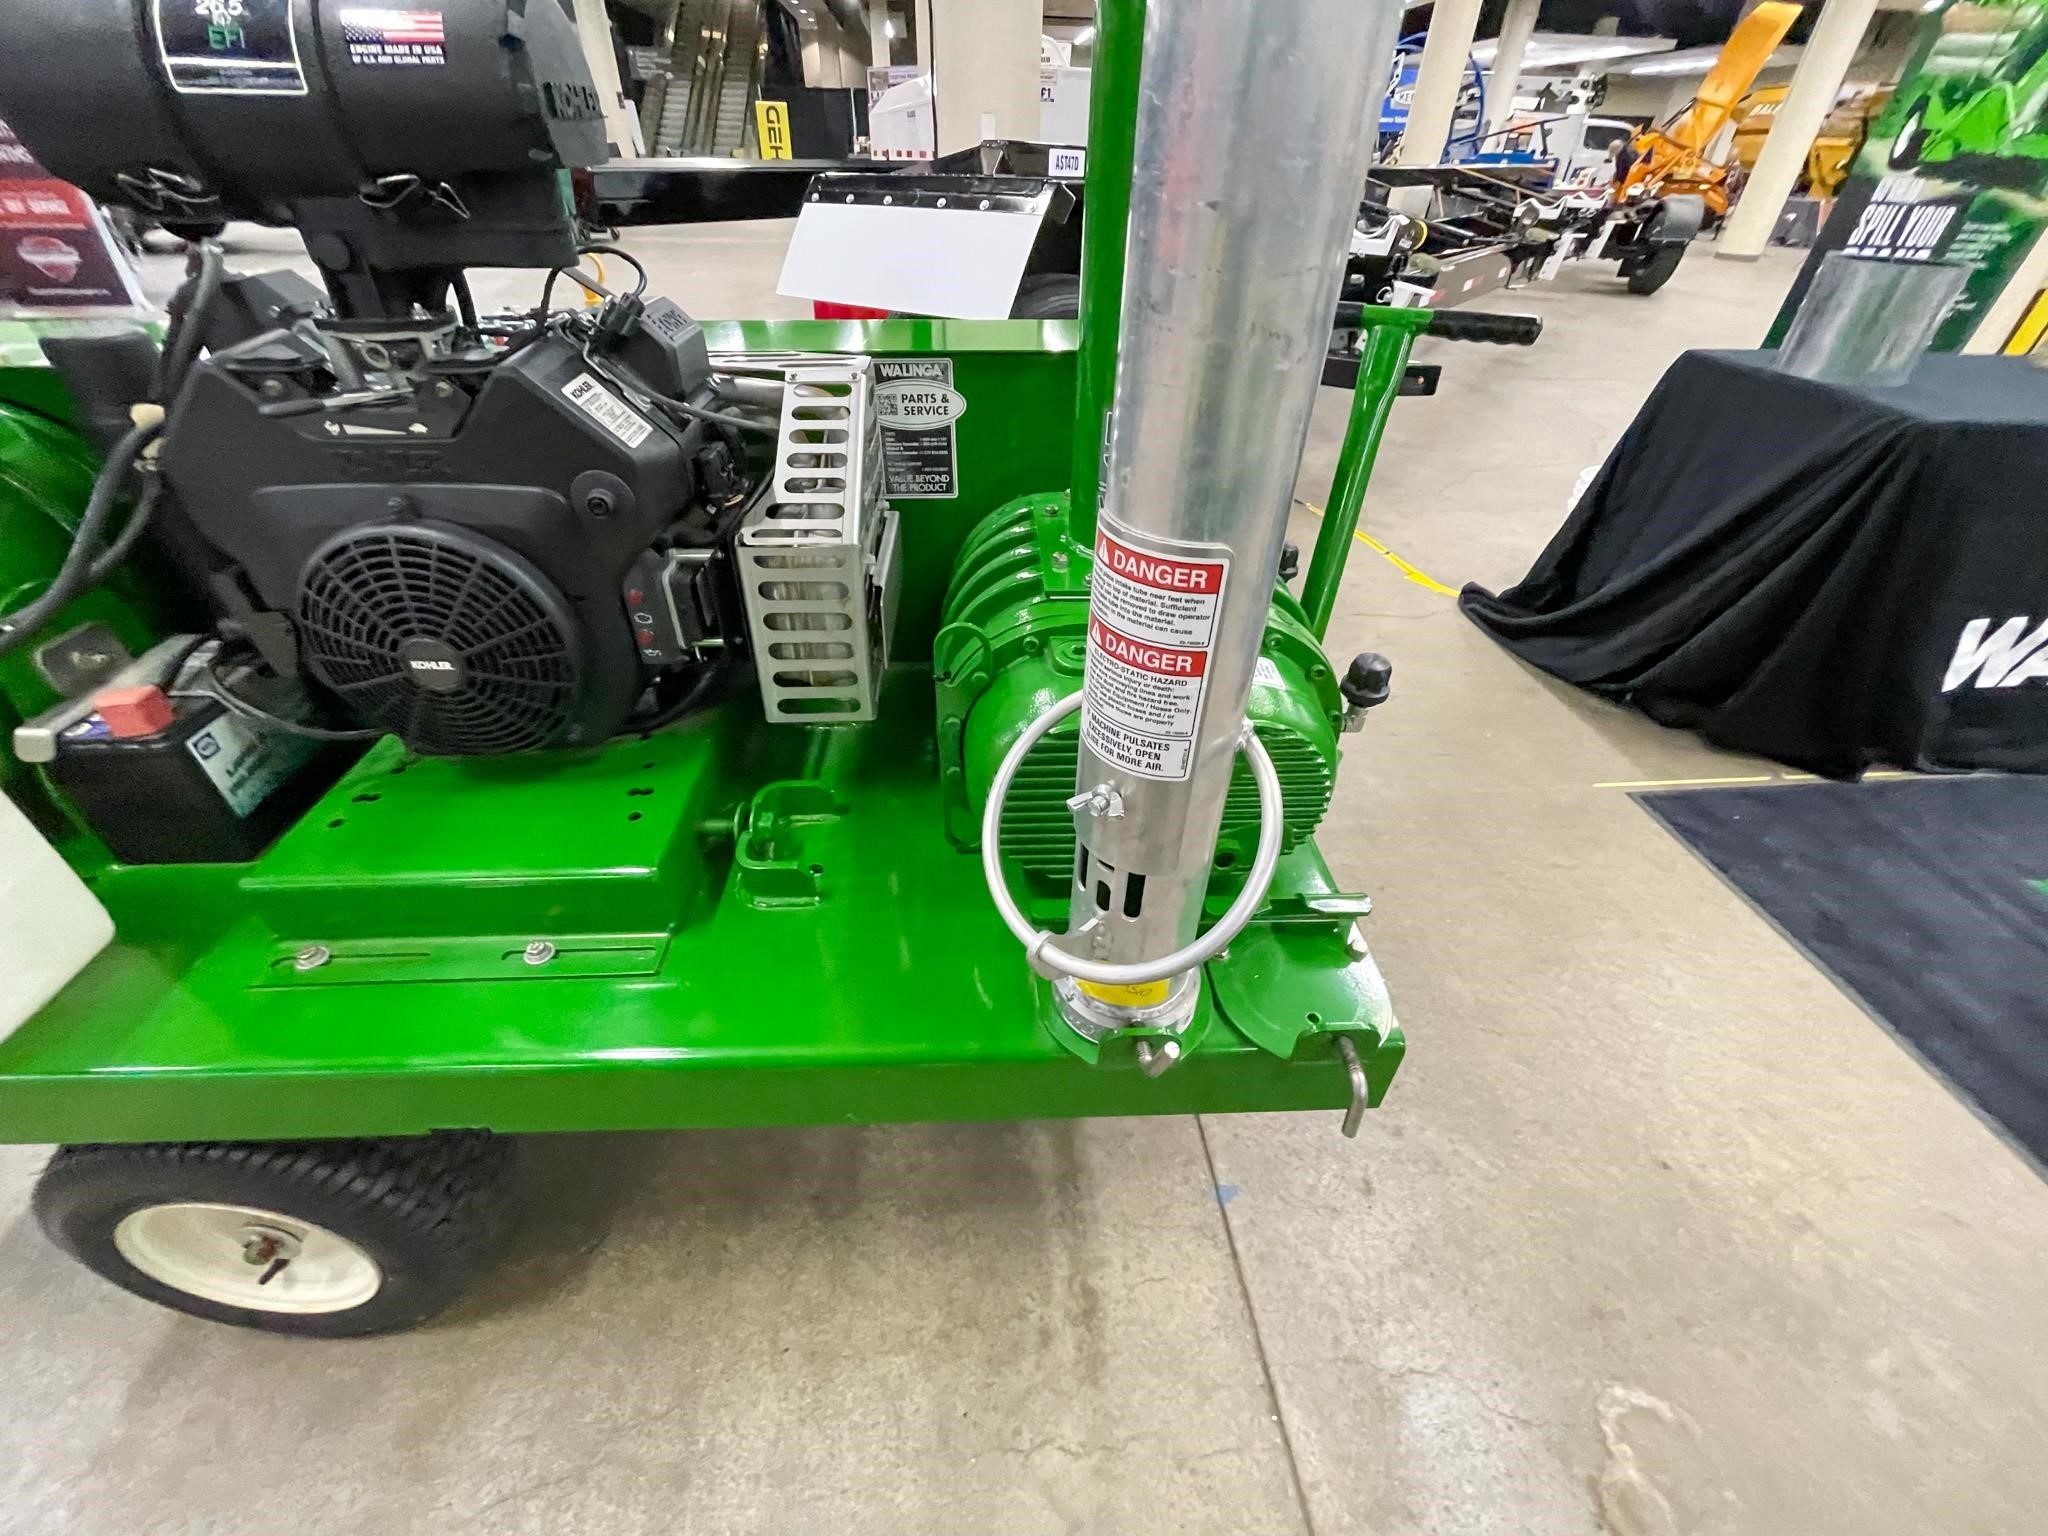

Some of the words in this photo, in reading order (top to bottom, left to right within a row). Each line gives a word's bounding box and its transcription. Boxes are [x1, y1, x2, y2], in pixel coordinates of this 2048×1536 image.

[350, 44, 382, 54] ENGINE
[384, 44, 410, 54] MADE
[411, 45, 422, 54] IN
[423, 45, 443, 54] USA
[421, 55, 445, 64] PARTS
[1846, 203, 1908, 247] SPILL
[1896, 204, 1957, 249] YOUR
[880, 363, 943, 377] WALINGA
[569, 380, 595, 400] KOHLER
[901, 393, 937, 404] PARTS
[941, 393, 950, 404] &
[904, 405, 949, 416] SERVICE
[889, 474, 914, 483] VALUE
[915, 474, 950, 483] BEYOND
[892, 483, 908, 492] THE
[910, 483, 947, 492] PRODUCT
[1113, 548, 1208, 589] DANGER
[1133, 586, 1148, 596] tube
[1149, 592, 1166, 600] near
[1168, 595, 1182, 603] feet
[1120, 598, 1147, 612] removed
[1158, 610, 1177, 618] draw
[1178, 613, 1210, 621] operator
[1160, 602, 1197, 612] Sufficient
[1127, 617, 1153, 629] material
[1132, 610, 1142, 618] the
[1144, 615, 1175, 626] material.
[1105, 632, 1193, 672] DANGER
[409, 660, 456, 671] KOHLER
[1094, 648, 1148, 681] ELECTRO-STATIC
[1150, 675, 1188, 687] HAZARD
[1124, 675, 1141, 687] injury
[1139, 688, 1155, 696] lines
[1112, 690, 1145, 707] Equipment
[1150, 704, 1172, 713] Hoses
[1139, 695, 1162, 704] hazard
[1145, 717, 1174, 727] properly
[1091, 712, 1121, 739] MACHINE
[1123, 733, 1170, 751] PULSATES
[1100, 742, 1114, 757] FOR
[1116, 752, 1142, 767] MORE
[1145, 762, 1164, 772] AIR.
[1135, 748, 1161, 760] OPEN
